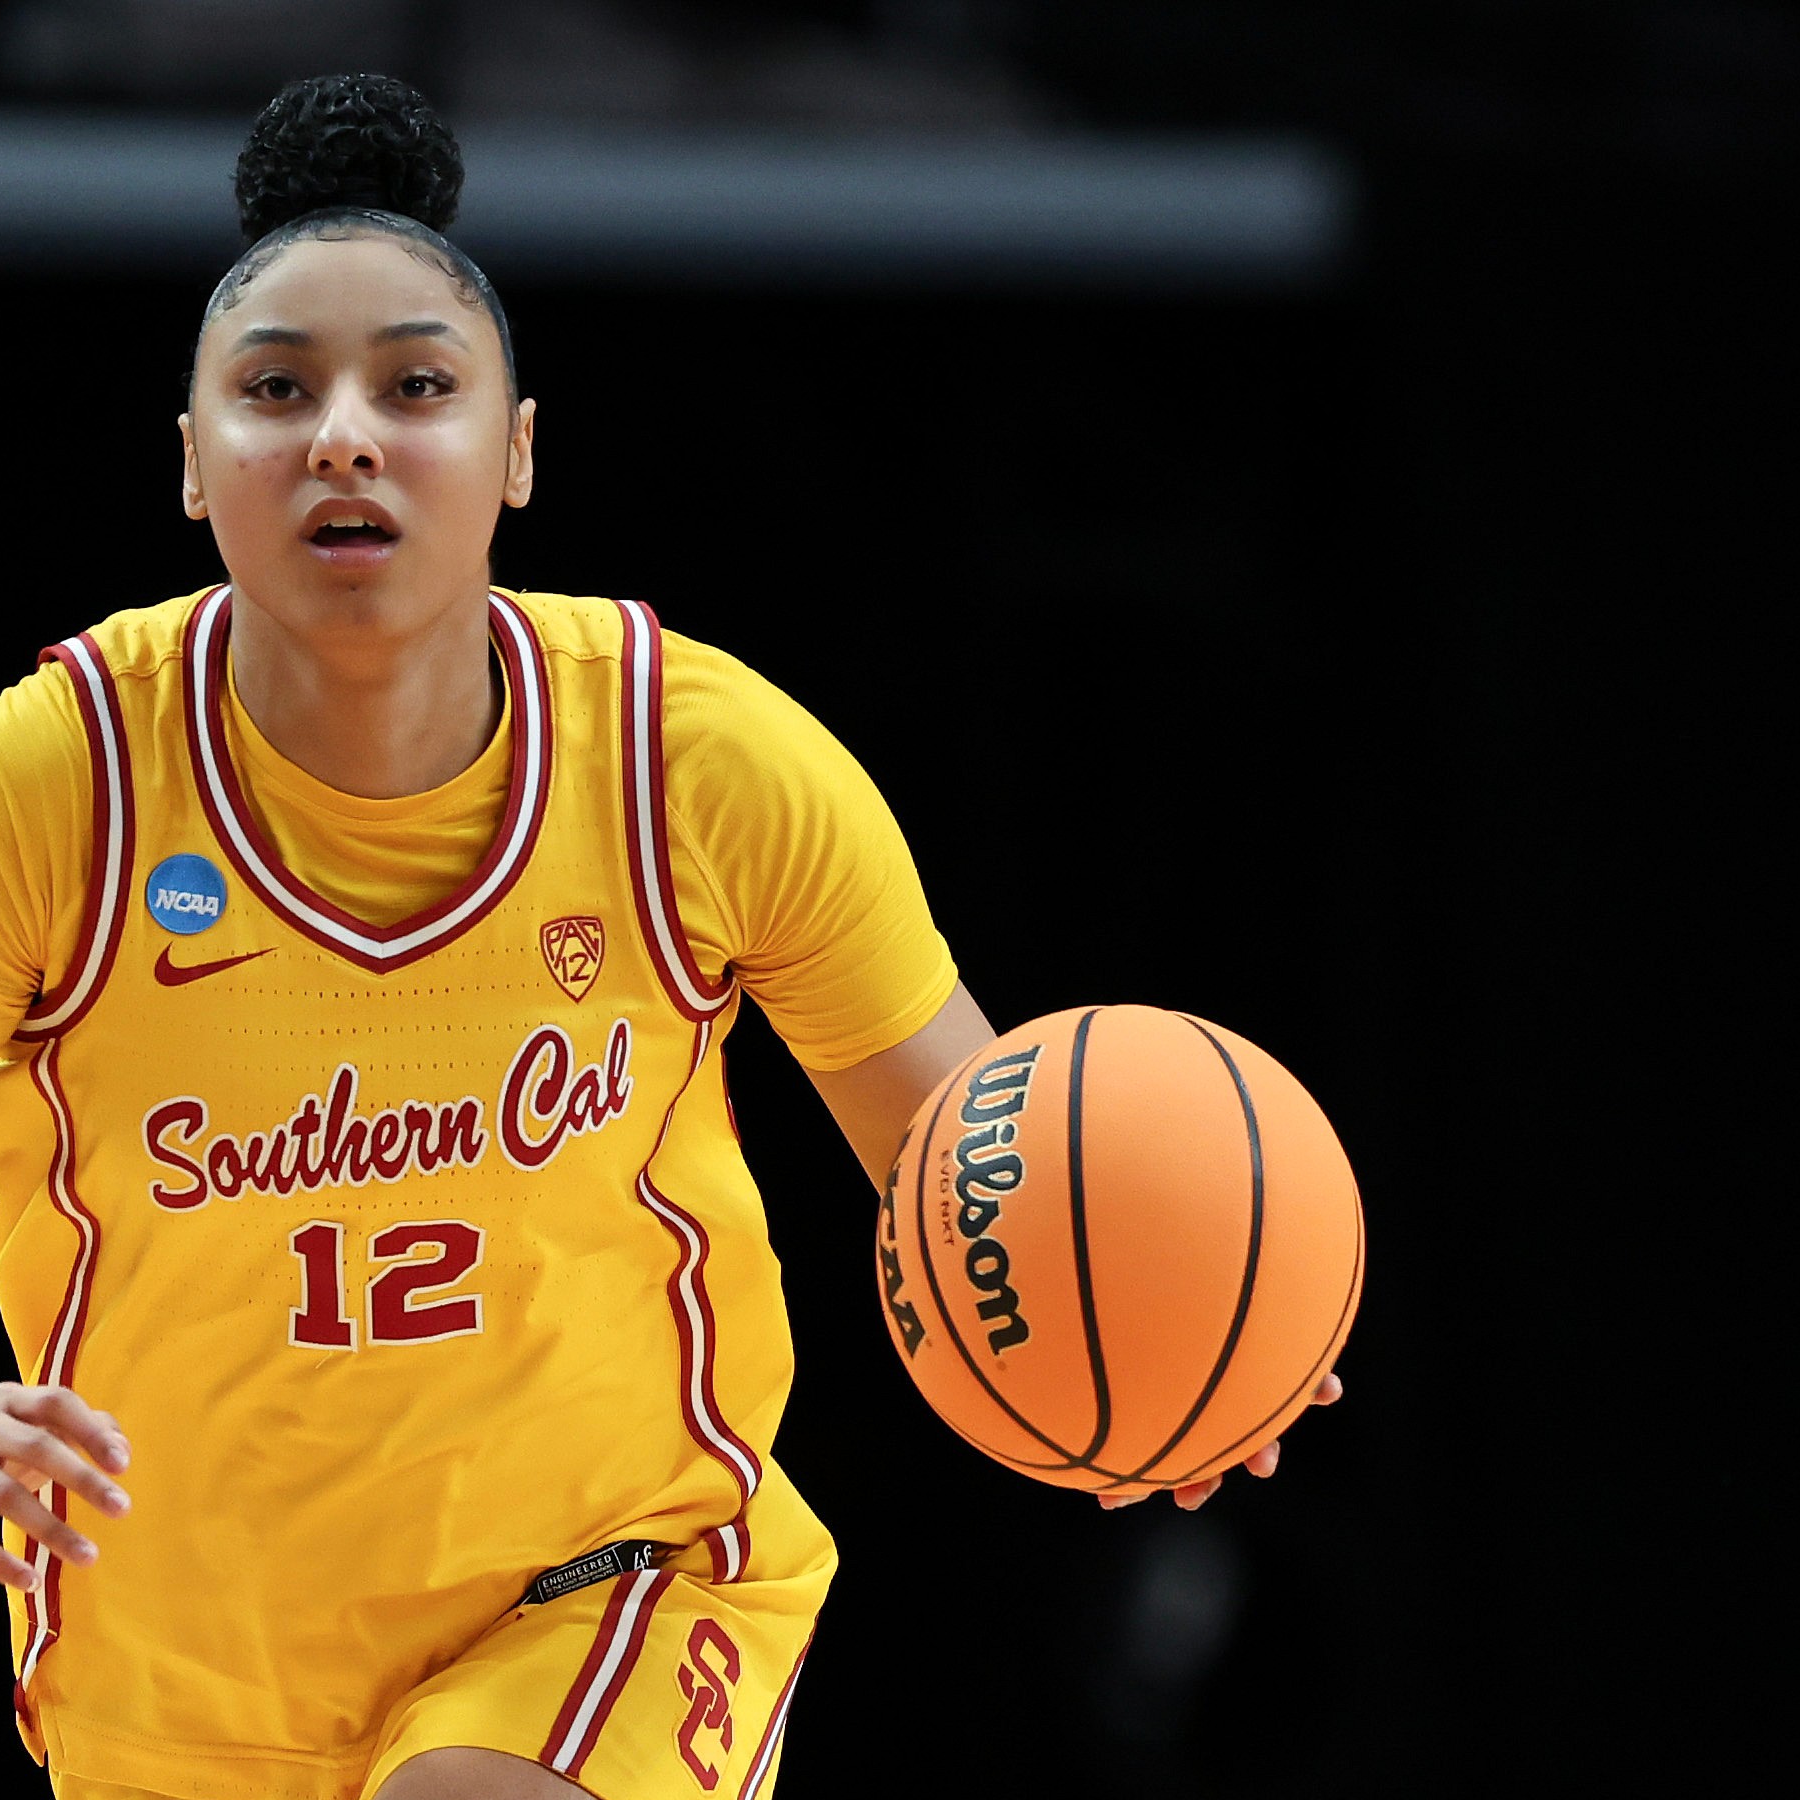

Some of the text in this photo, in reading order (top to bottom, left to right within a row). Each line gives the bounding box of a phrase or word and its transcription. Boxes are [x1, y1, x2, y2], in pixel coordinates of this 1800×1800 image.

[154, 888, 219, 919] NCAA
[545, 918, 600, 970] PAC
[561, 951, 591, 983] 12
[143, 1017, 634, 1213] Southern Cal
[940, 1202, 955, 1247] NXT
[952, 1043, 1046, 1357] Wilson
[878, 1124, 926, 1359] CAA
[288, 1219, 486, 1351] 12
[542, 1553, 612, 1588] ENGINEERED
